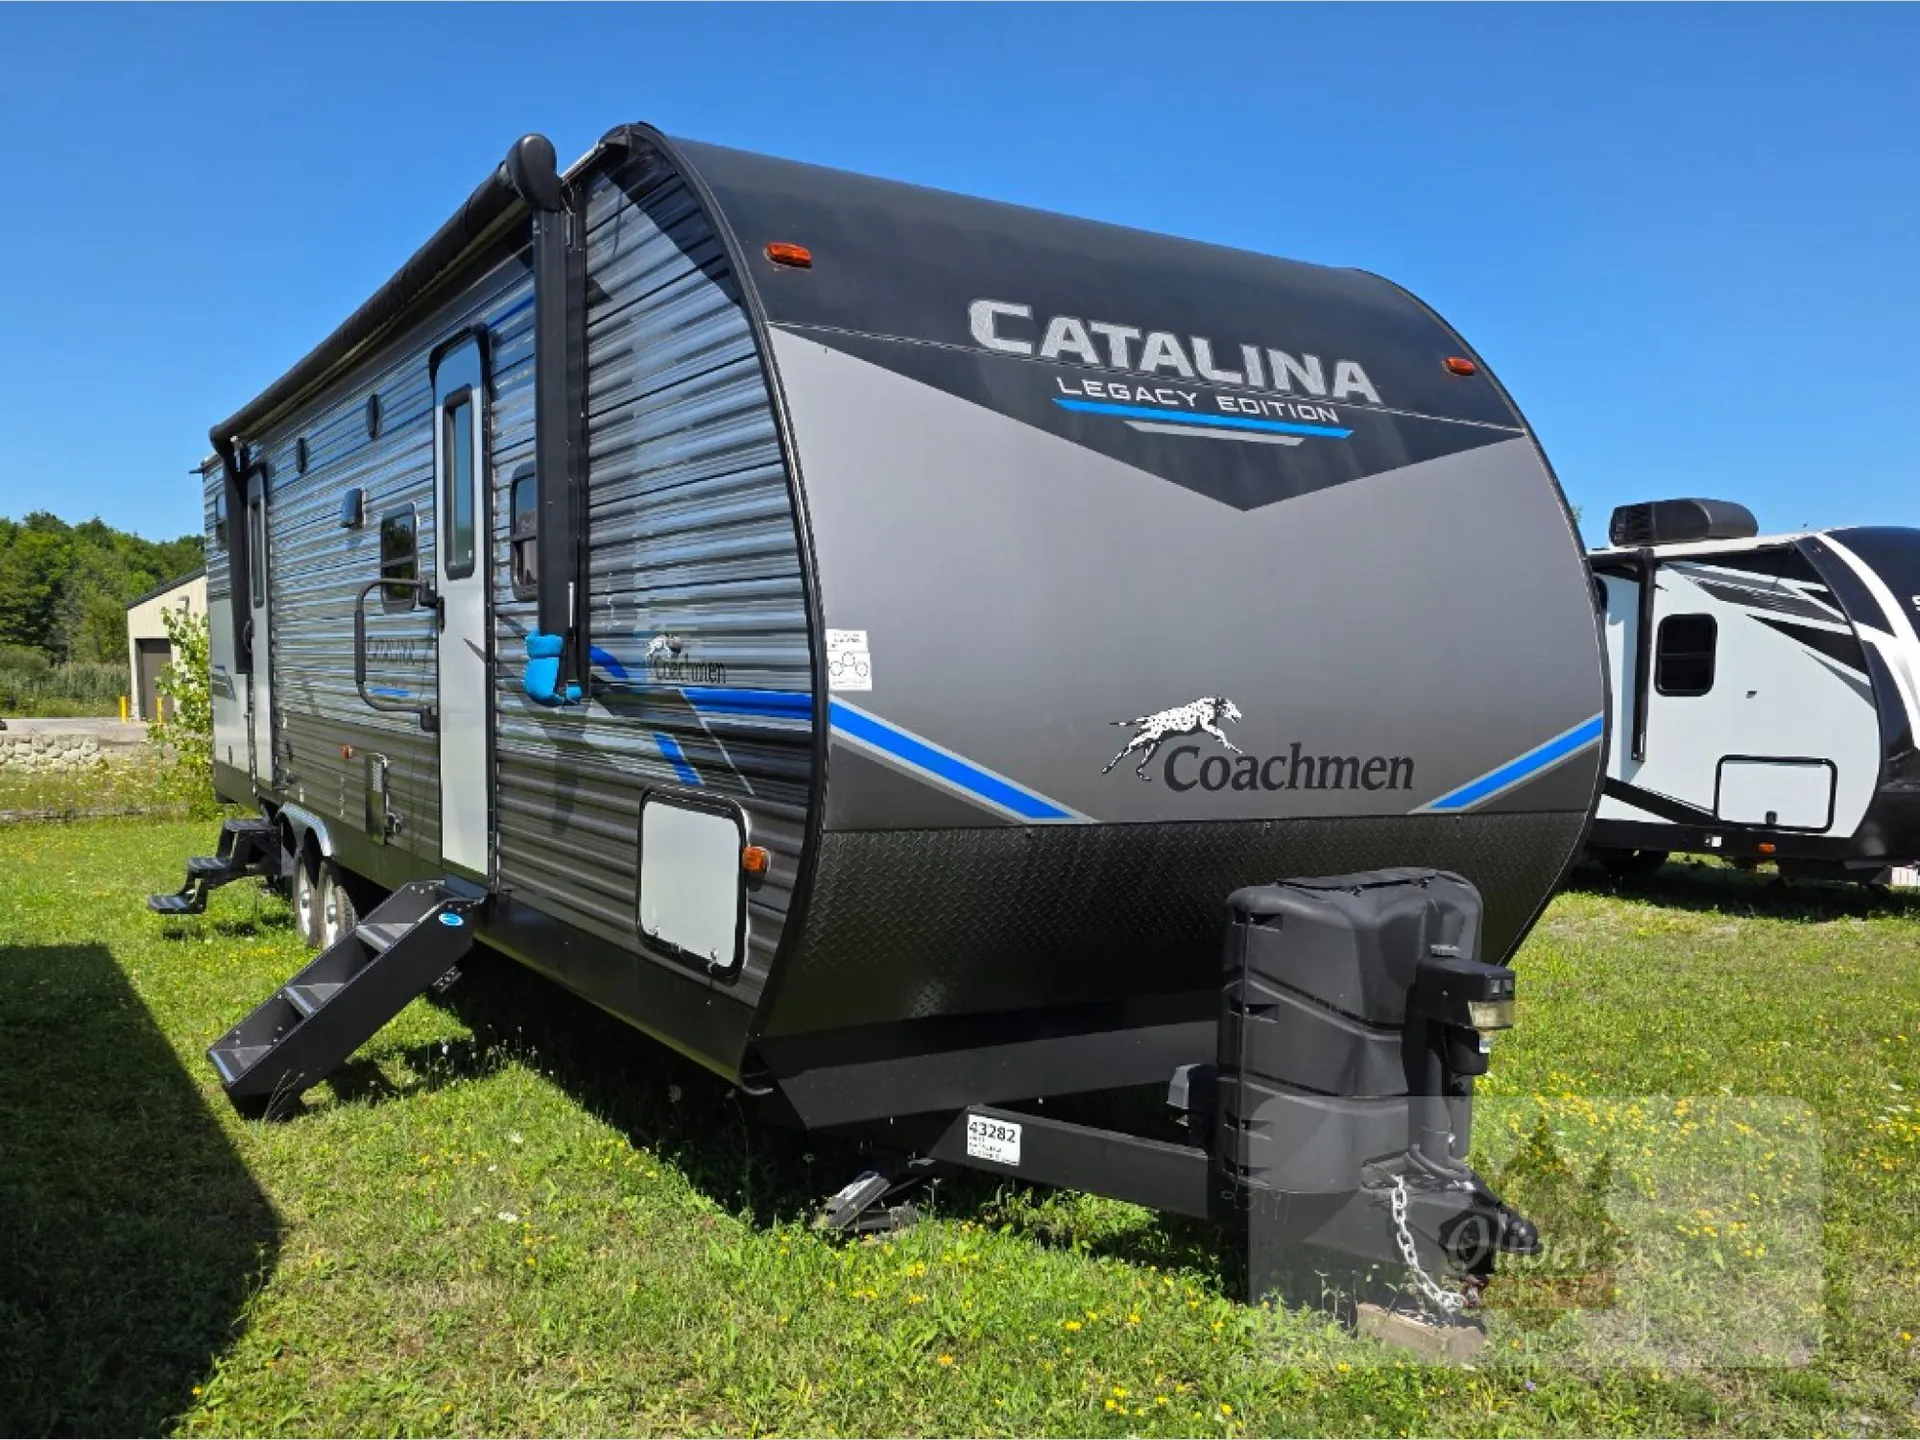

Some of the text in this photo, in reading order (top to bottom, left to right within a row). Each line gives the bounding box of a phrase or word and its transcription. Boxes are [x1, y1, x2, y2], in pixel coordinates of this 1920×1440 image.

[967, 297, 1384, 404] CATALINA
[1055, 376, 1340, 424] LEGACY EDITION
[1163, 742, 1416, 792] Coachmen
[969, 1121, 1017, 1144] 43282
